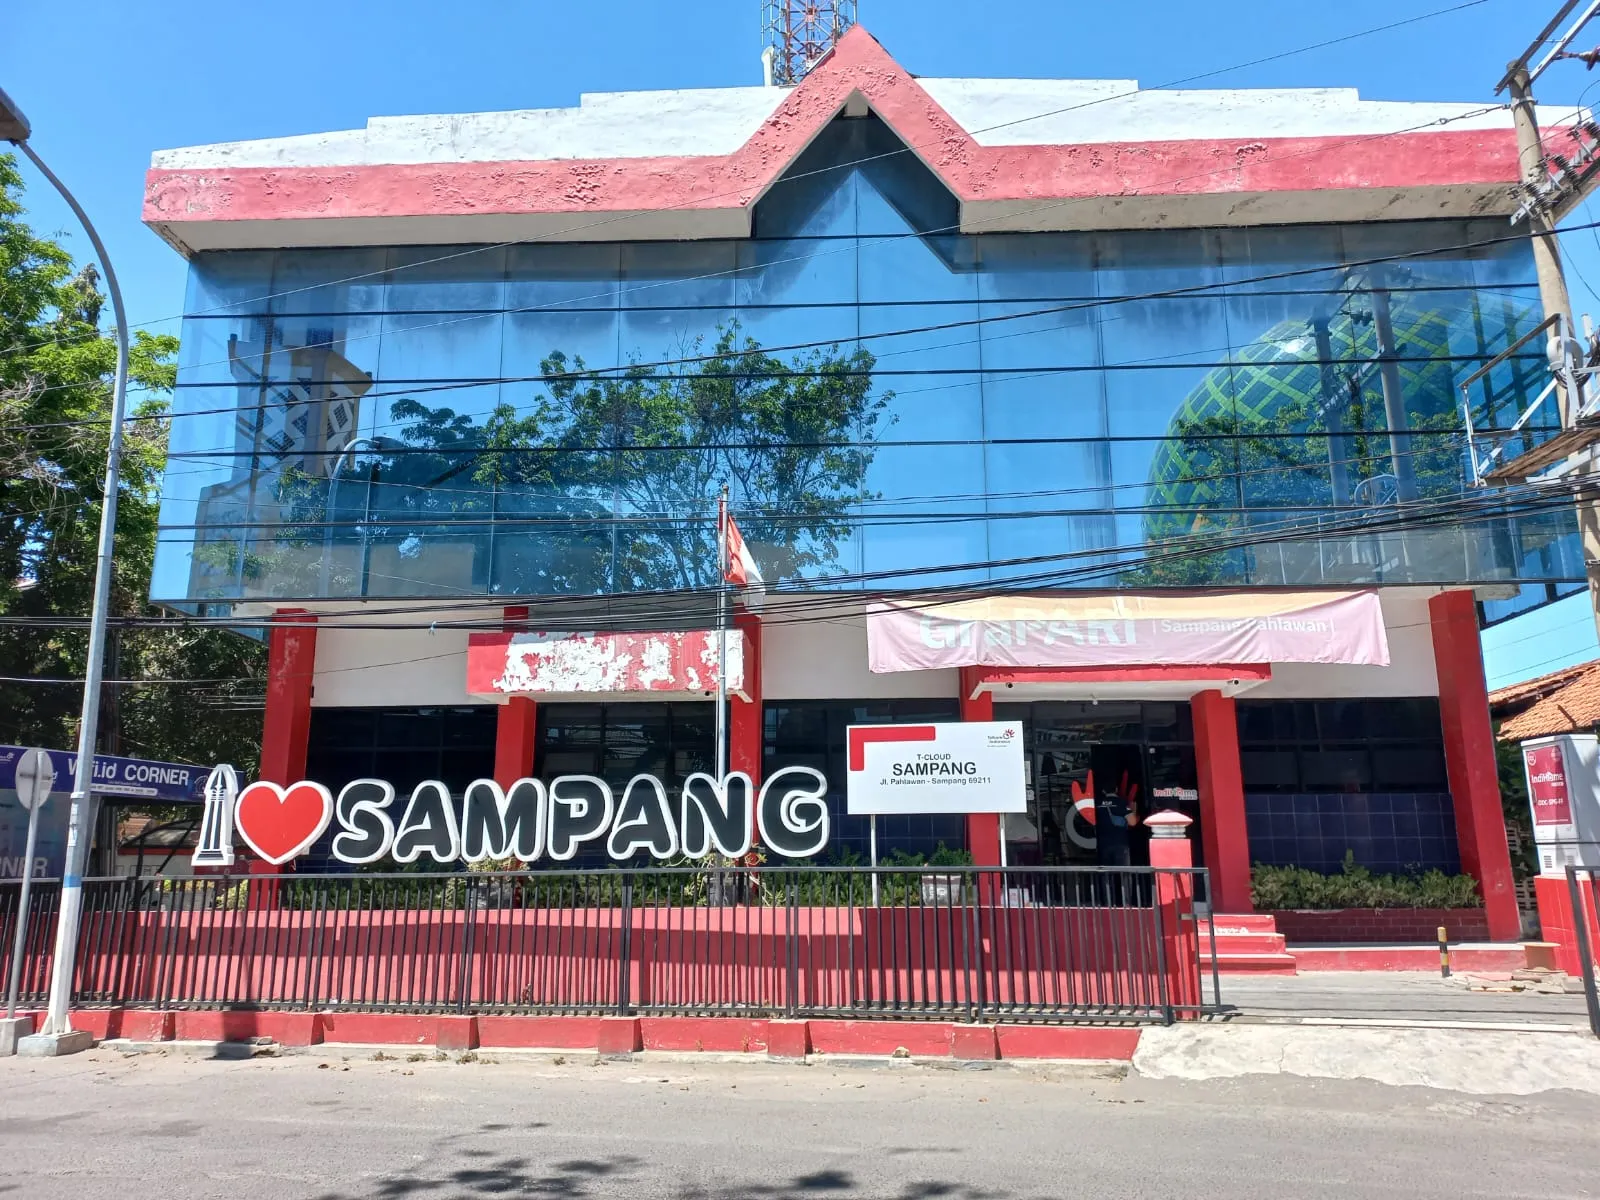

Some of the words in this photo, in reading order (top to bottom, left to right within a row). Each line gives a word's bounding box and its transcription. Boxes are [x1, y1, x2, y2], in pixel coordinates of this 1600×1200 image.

[1255, 616, 1327, 633] ahlawan
[917, 753, 951, 761] T-CLOUD
[124, 764, 190, 787] CORNER
[892, 762, 977, 776] SAMPANG
[931, 777, 967, 786] Sampang
[332, 766, 830, 864] SAMPANG
